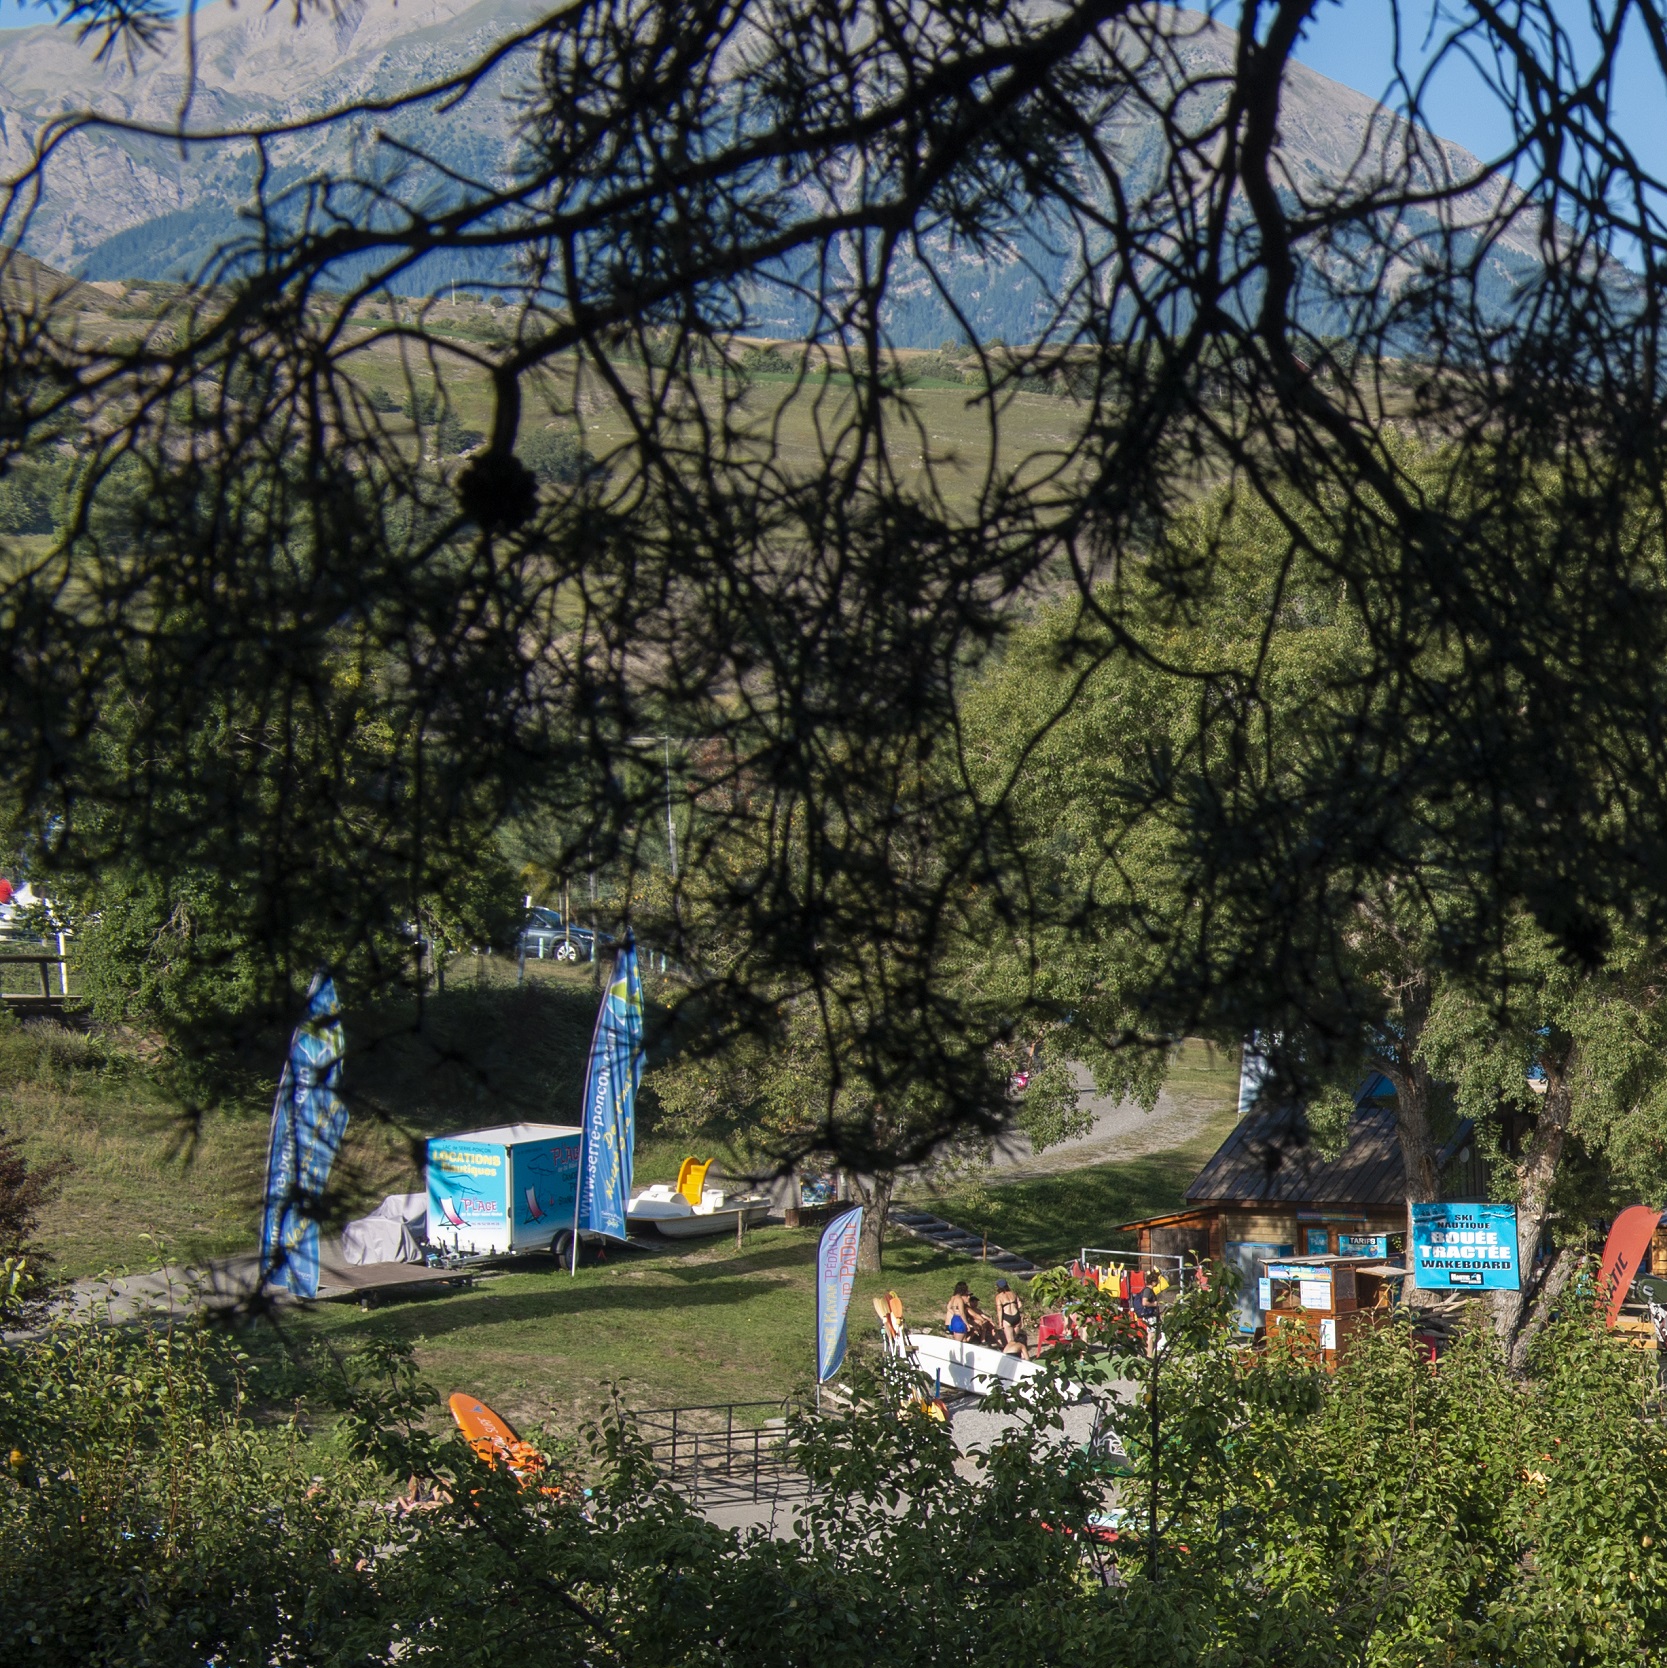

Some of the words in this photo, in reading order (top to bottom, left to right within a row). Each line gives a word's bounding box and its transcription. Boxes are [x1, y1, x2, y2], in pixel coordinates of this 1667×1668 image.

[433, 1150, 501, 1167] LOCATIONS
[551, 1145, 580, 1166] PLAG
[461, 1198, 497, 1212] PLAGE
[1437, 1221, 1491, 1230] NAUTIQUE
[1350, 1237, 1376, 1245] TARIFS
[1430, 1230, 1498, 1245] BOUÉE
[824, 1231, 839, 1284] PÉDALO
[839, 1221, 857, 1283] PADDLE
[1419, 1244, 1512, 1259] TRACTÉE
[1421, 1260, 1511, 1270] WAKEBOARD
[824, 1283, 838, 1324] KAYAK
